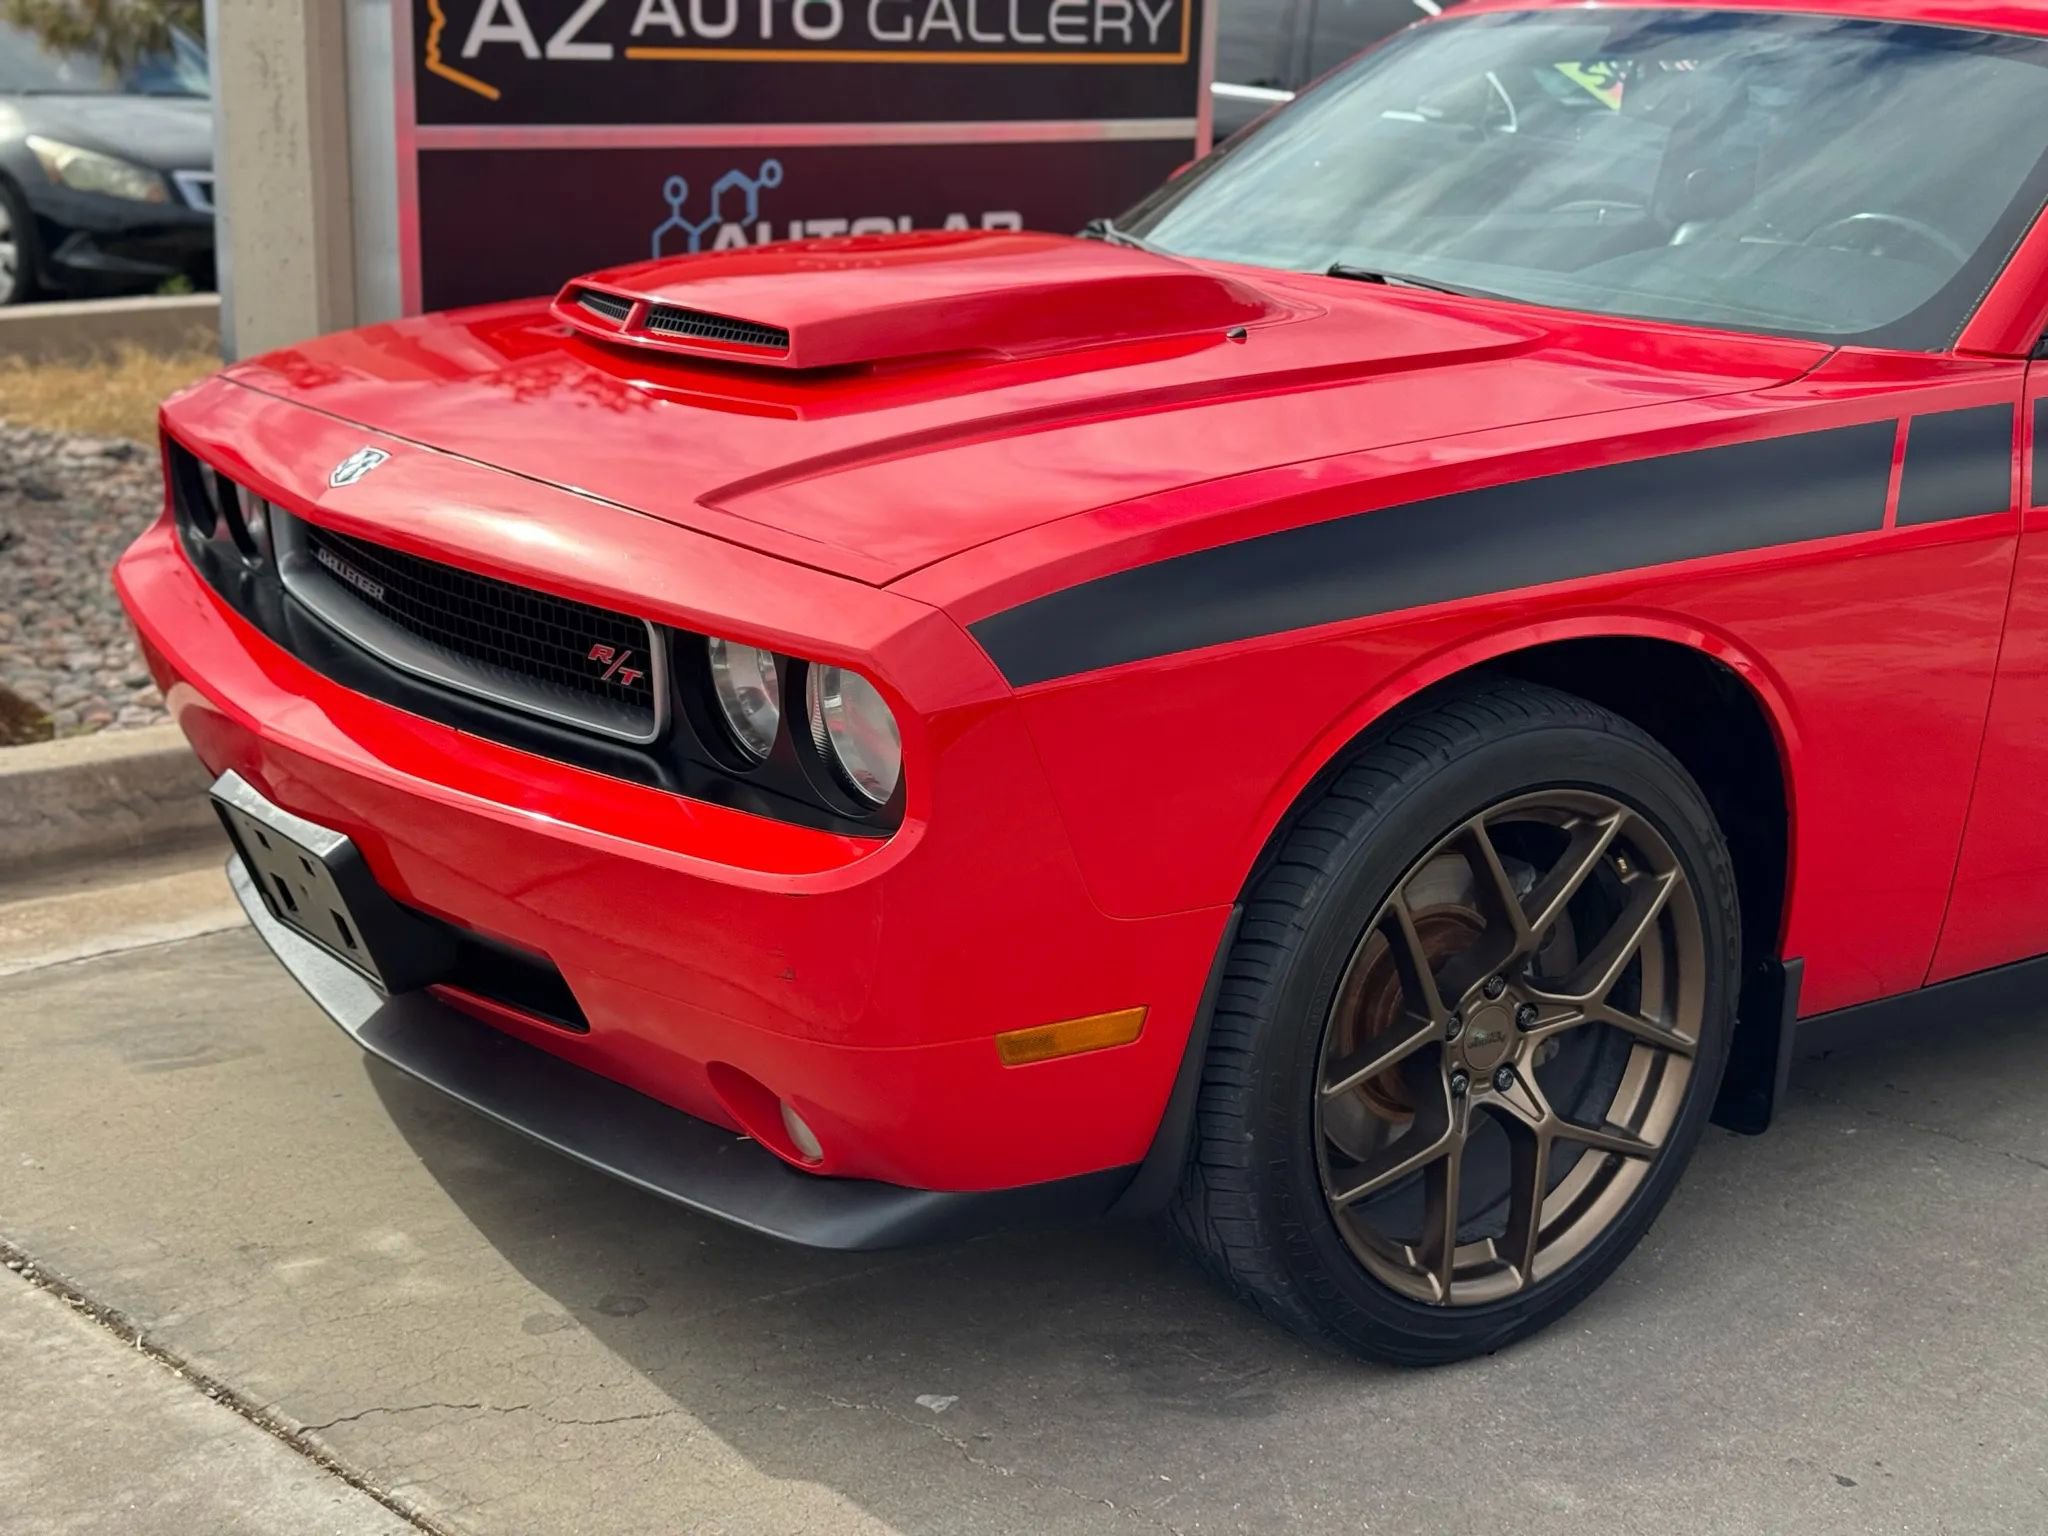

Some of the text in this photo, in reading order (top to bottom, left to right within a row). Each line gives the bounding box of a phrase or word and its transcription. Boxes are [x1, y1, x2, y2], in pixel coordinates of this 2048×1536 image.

[461, 0, 1173, 60] AZ AUTO GALLERY
[587, 643, 645, 686] R/T
